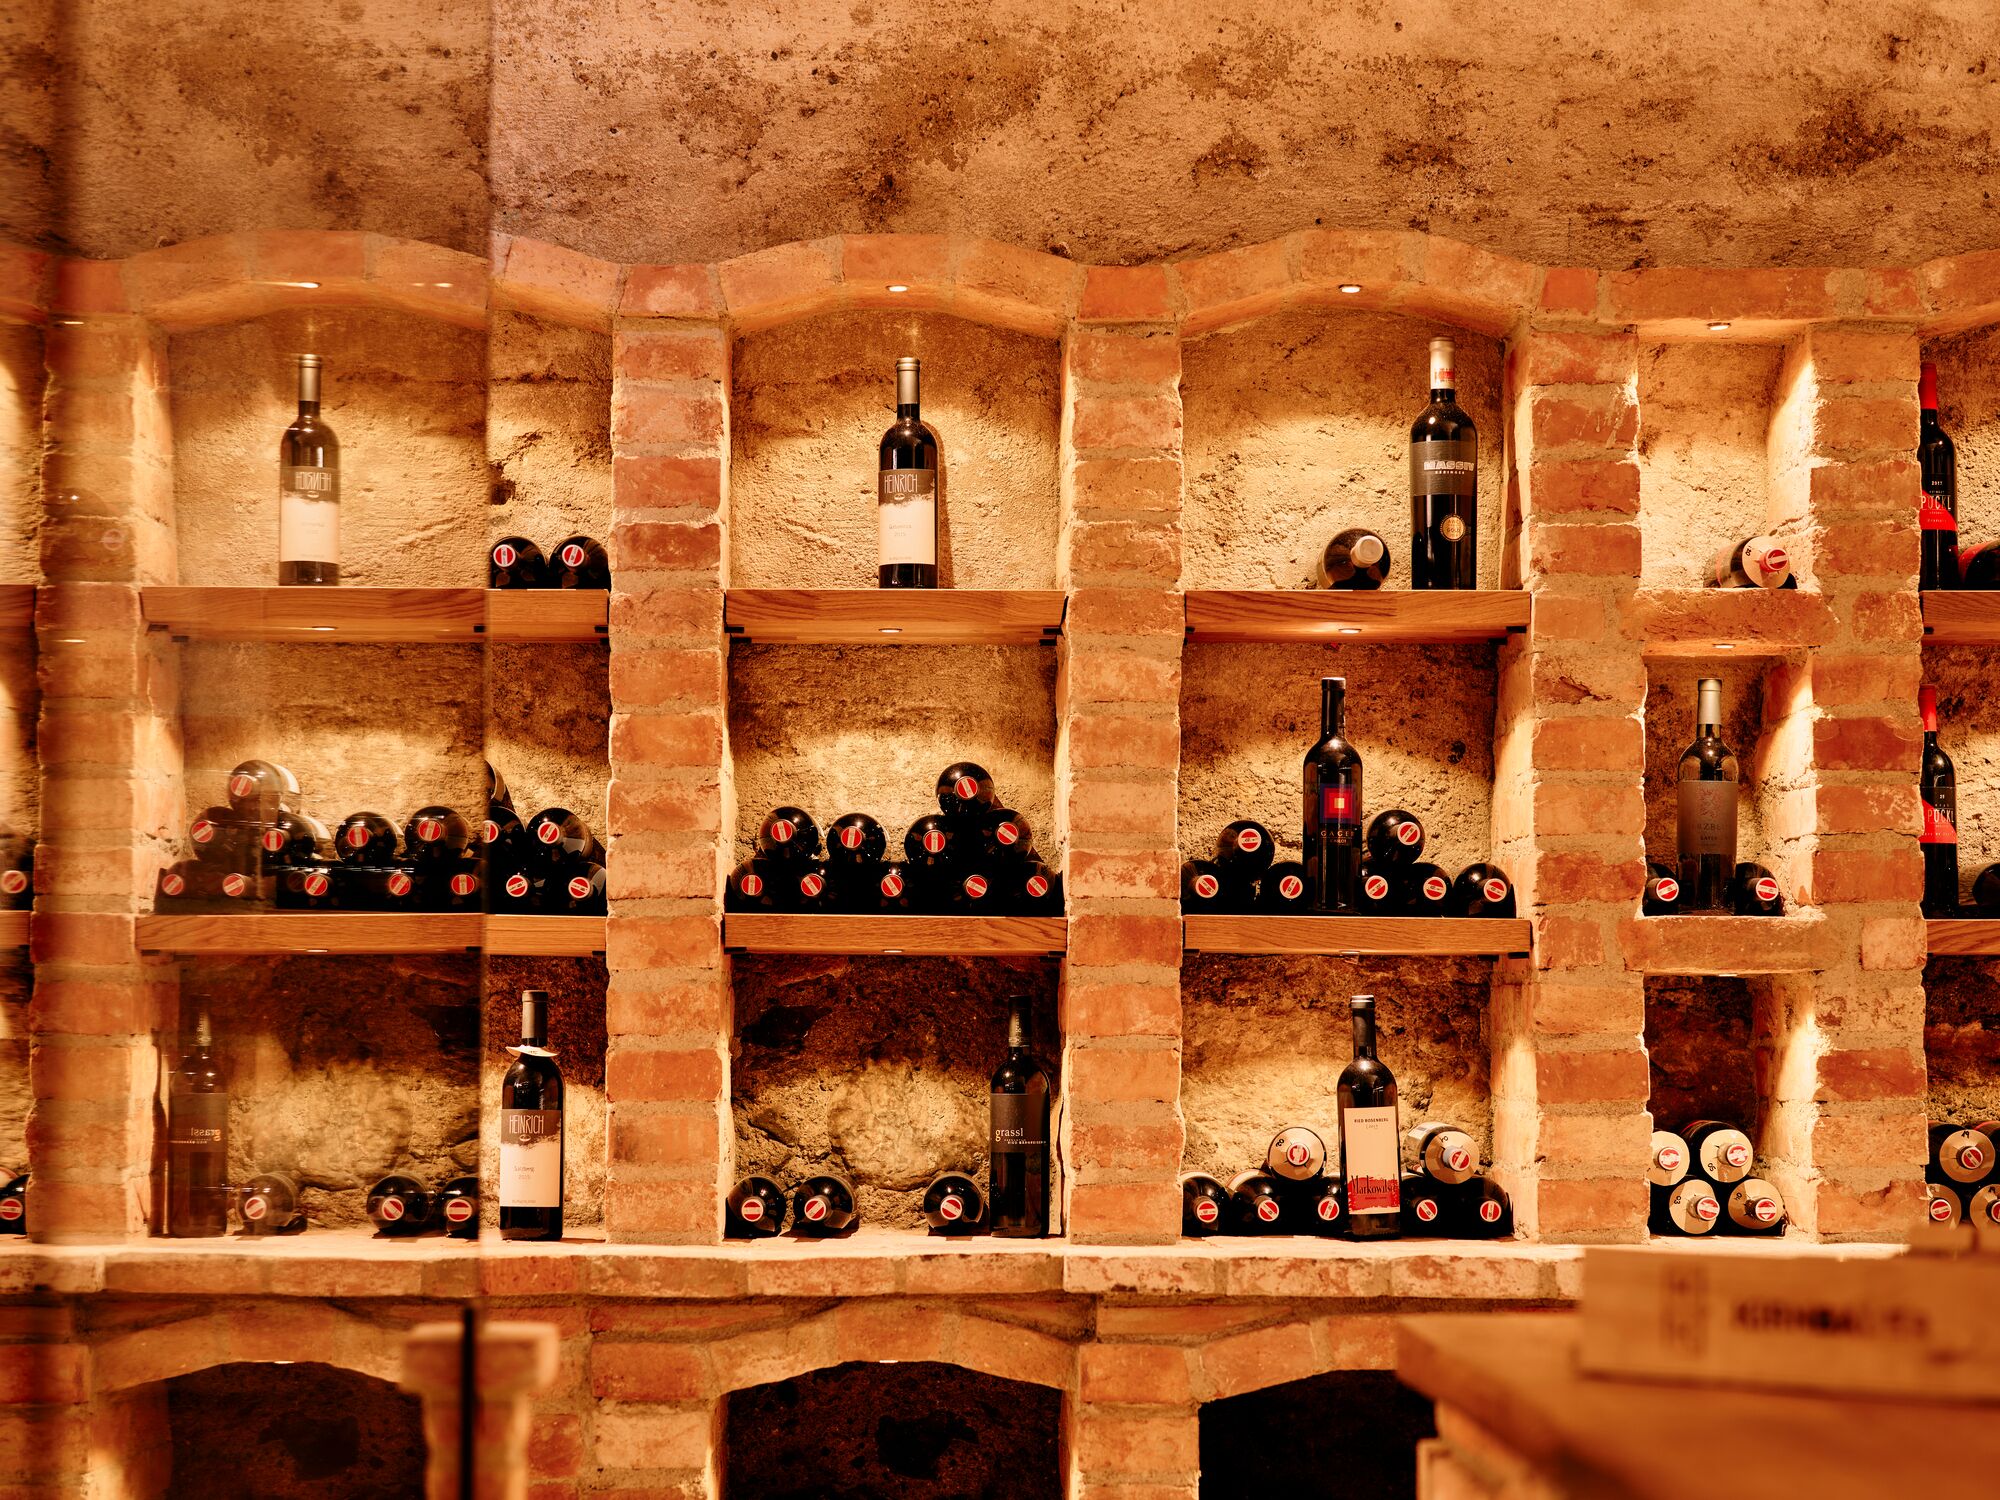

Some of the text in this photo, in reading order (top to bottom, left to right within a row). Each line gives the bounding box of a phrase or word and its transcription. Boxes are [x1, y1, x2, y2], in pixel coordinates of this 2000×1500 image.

[884, 474, 918, 494] HEINRICH
[509, 1114, 544, 1135] HEINRICH
[995, 1127, 1024, 1142] grassl
